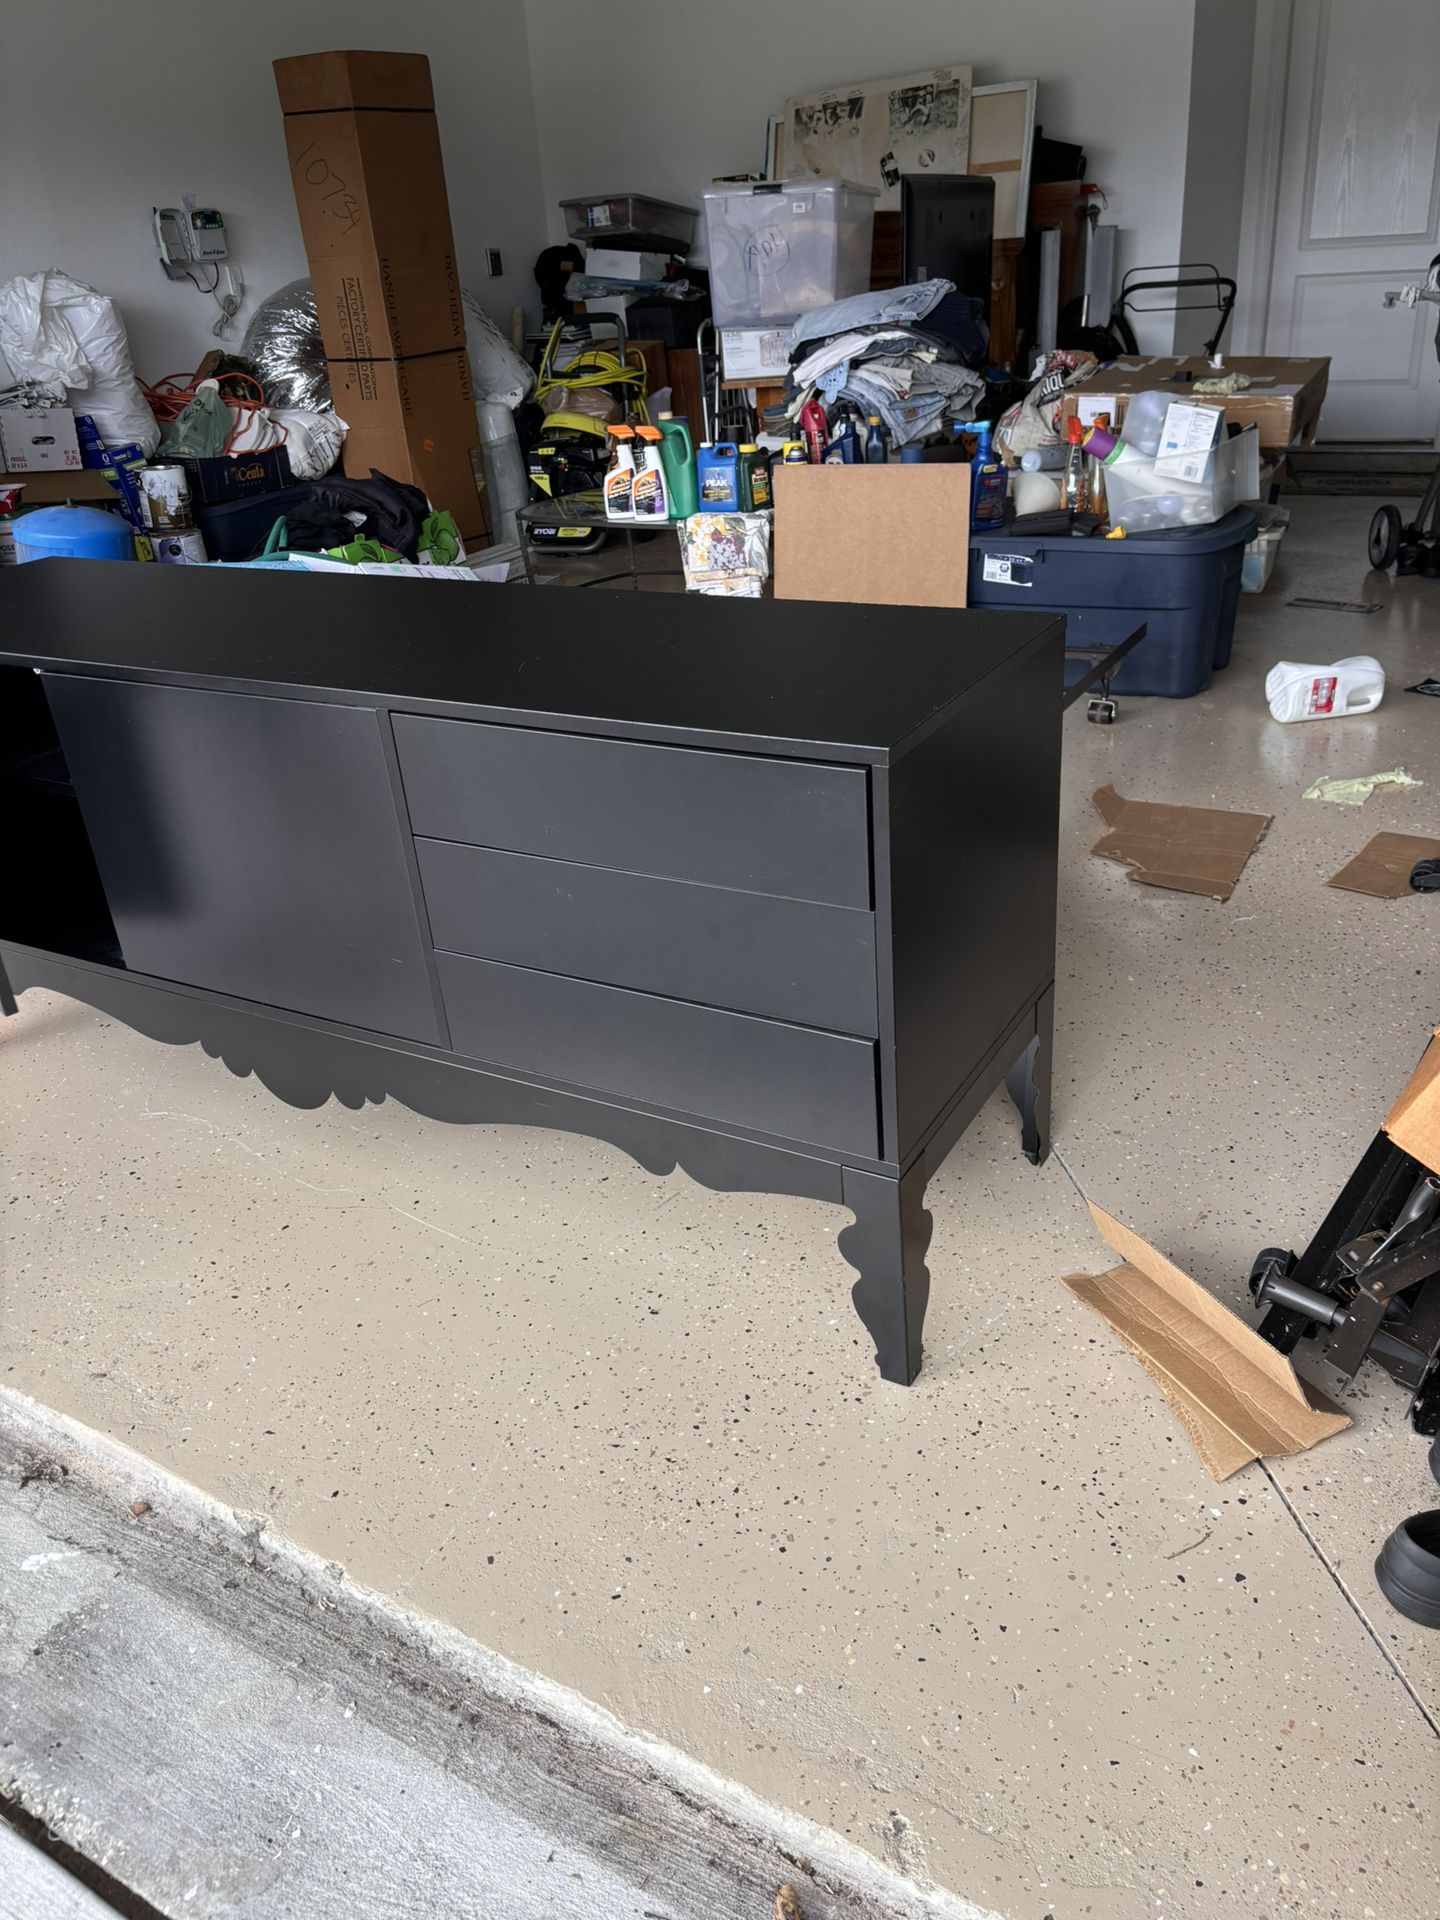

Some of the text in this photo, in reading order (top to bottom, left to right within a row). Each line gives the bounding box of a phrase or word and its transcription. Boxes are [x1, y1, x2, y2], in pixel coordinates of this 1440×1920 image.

[346, 277, 360, 322] FACTORY
[361, 373, 373, 401] PARTS
[705, 479, 728, 487] PEAK
[533, 527, 557, 536] RYOBI
